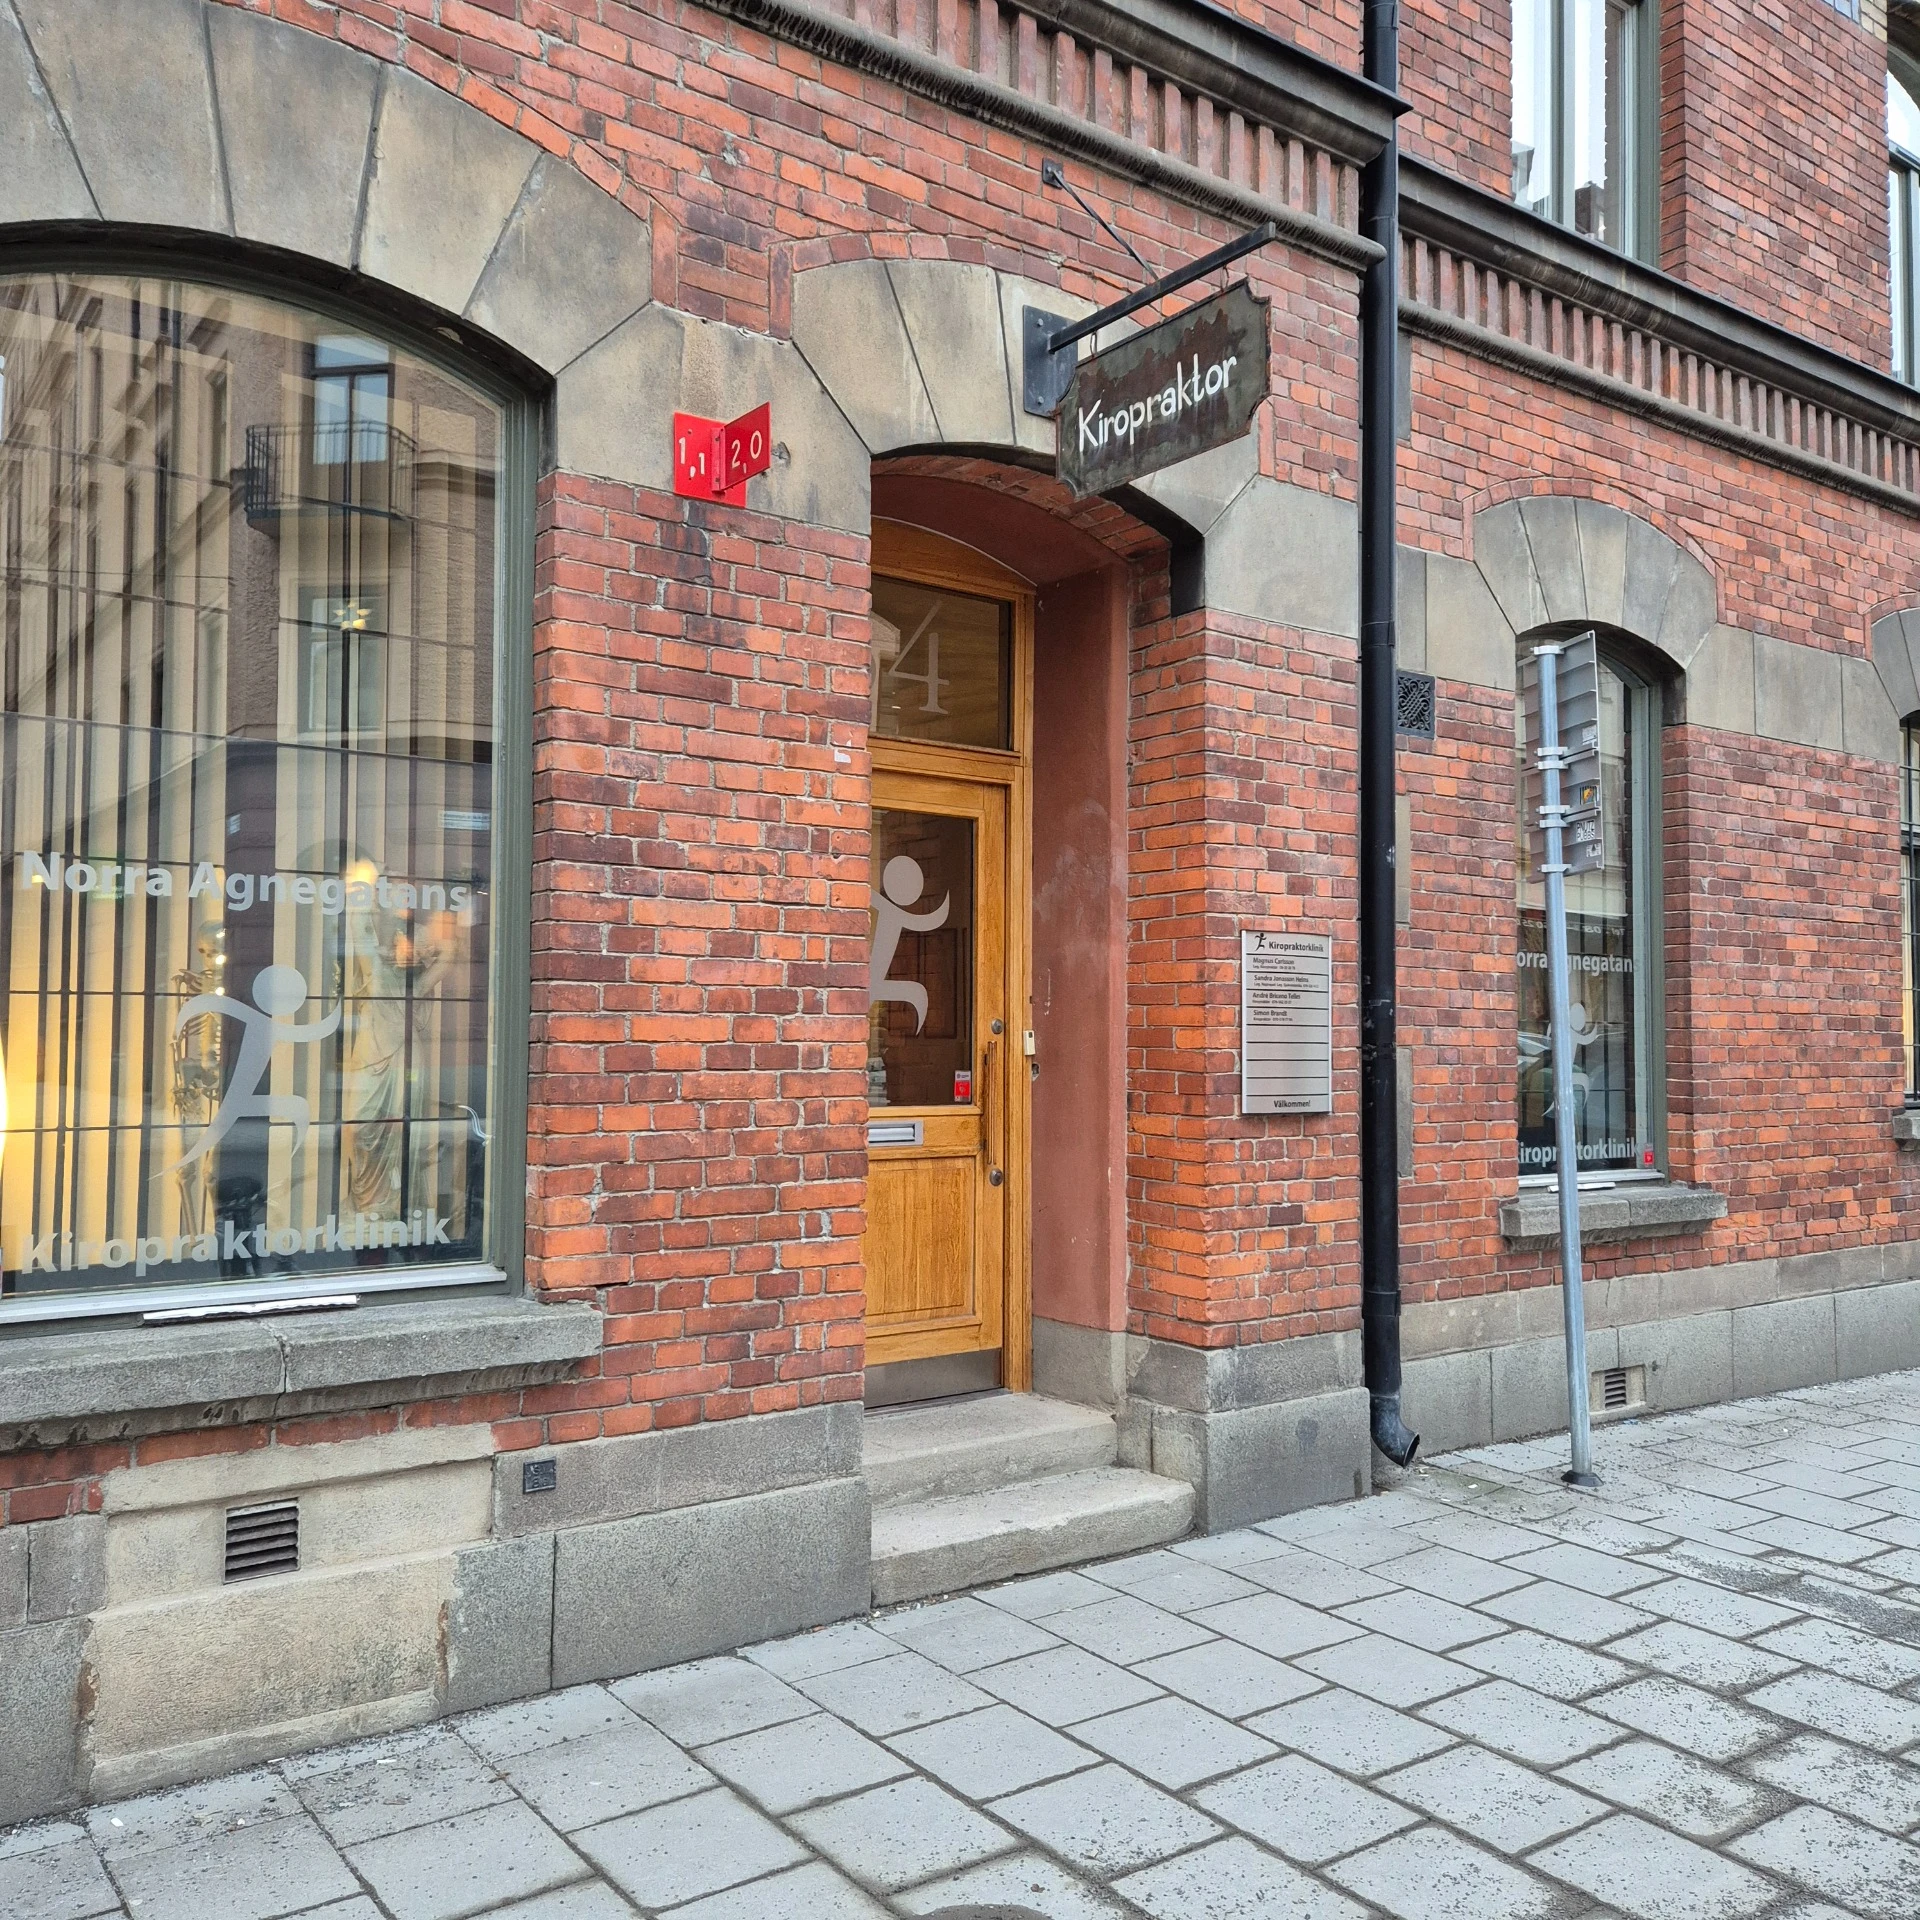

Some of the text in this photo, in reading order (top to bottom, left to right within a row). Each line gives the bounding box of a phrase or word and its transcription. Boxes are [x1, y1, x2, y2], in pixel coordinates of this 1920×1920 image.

[1079, 353, 1237, 451] Kiropraktor
[888, 600, 950, 715] 4
[20, 849, 468, 916] Norra Agnegatans
[1268, 941, 1324, 952] Kiropraktorklinik
[1516, 951, 1548, 969] orra
[1254, 974, 1273, 982] Sandra
[1270, 1009, 1288, 1017] Brandt
[1273, 1099, 1311, 1108] Välkommen!
[1517, 1136, 1645, 1168] iroprtorklinik
[20, 1208, 453, 1277] Kiropraktorklinik
